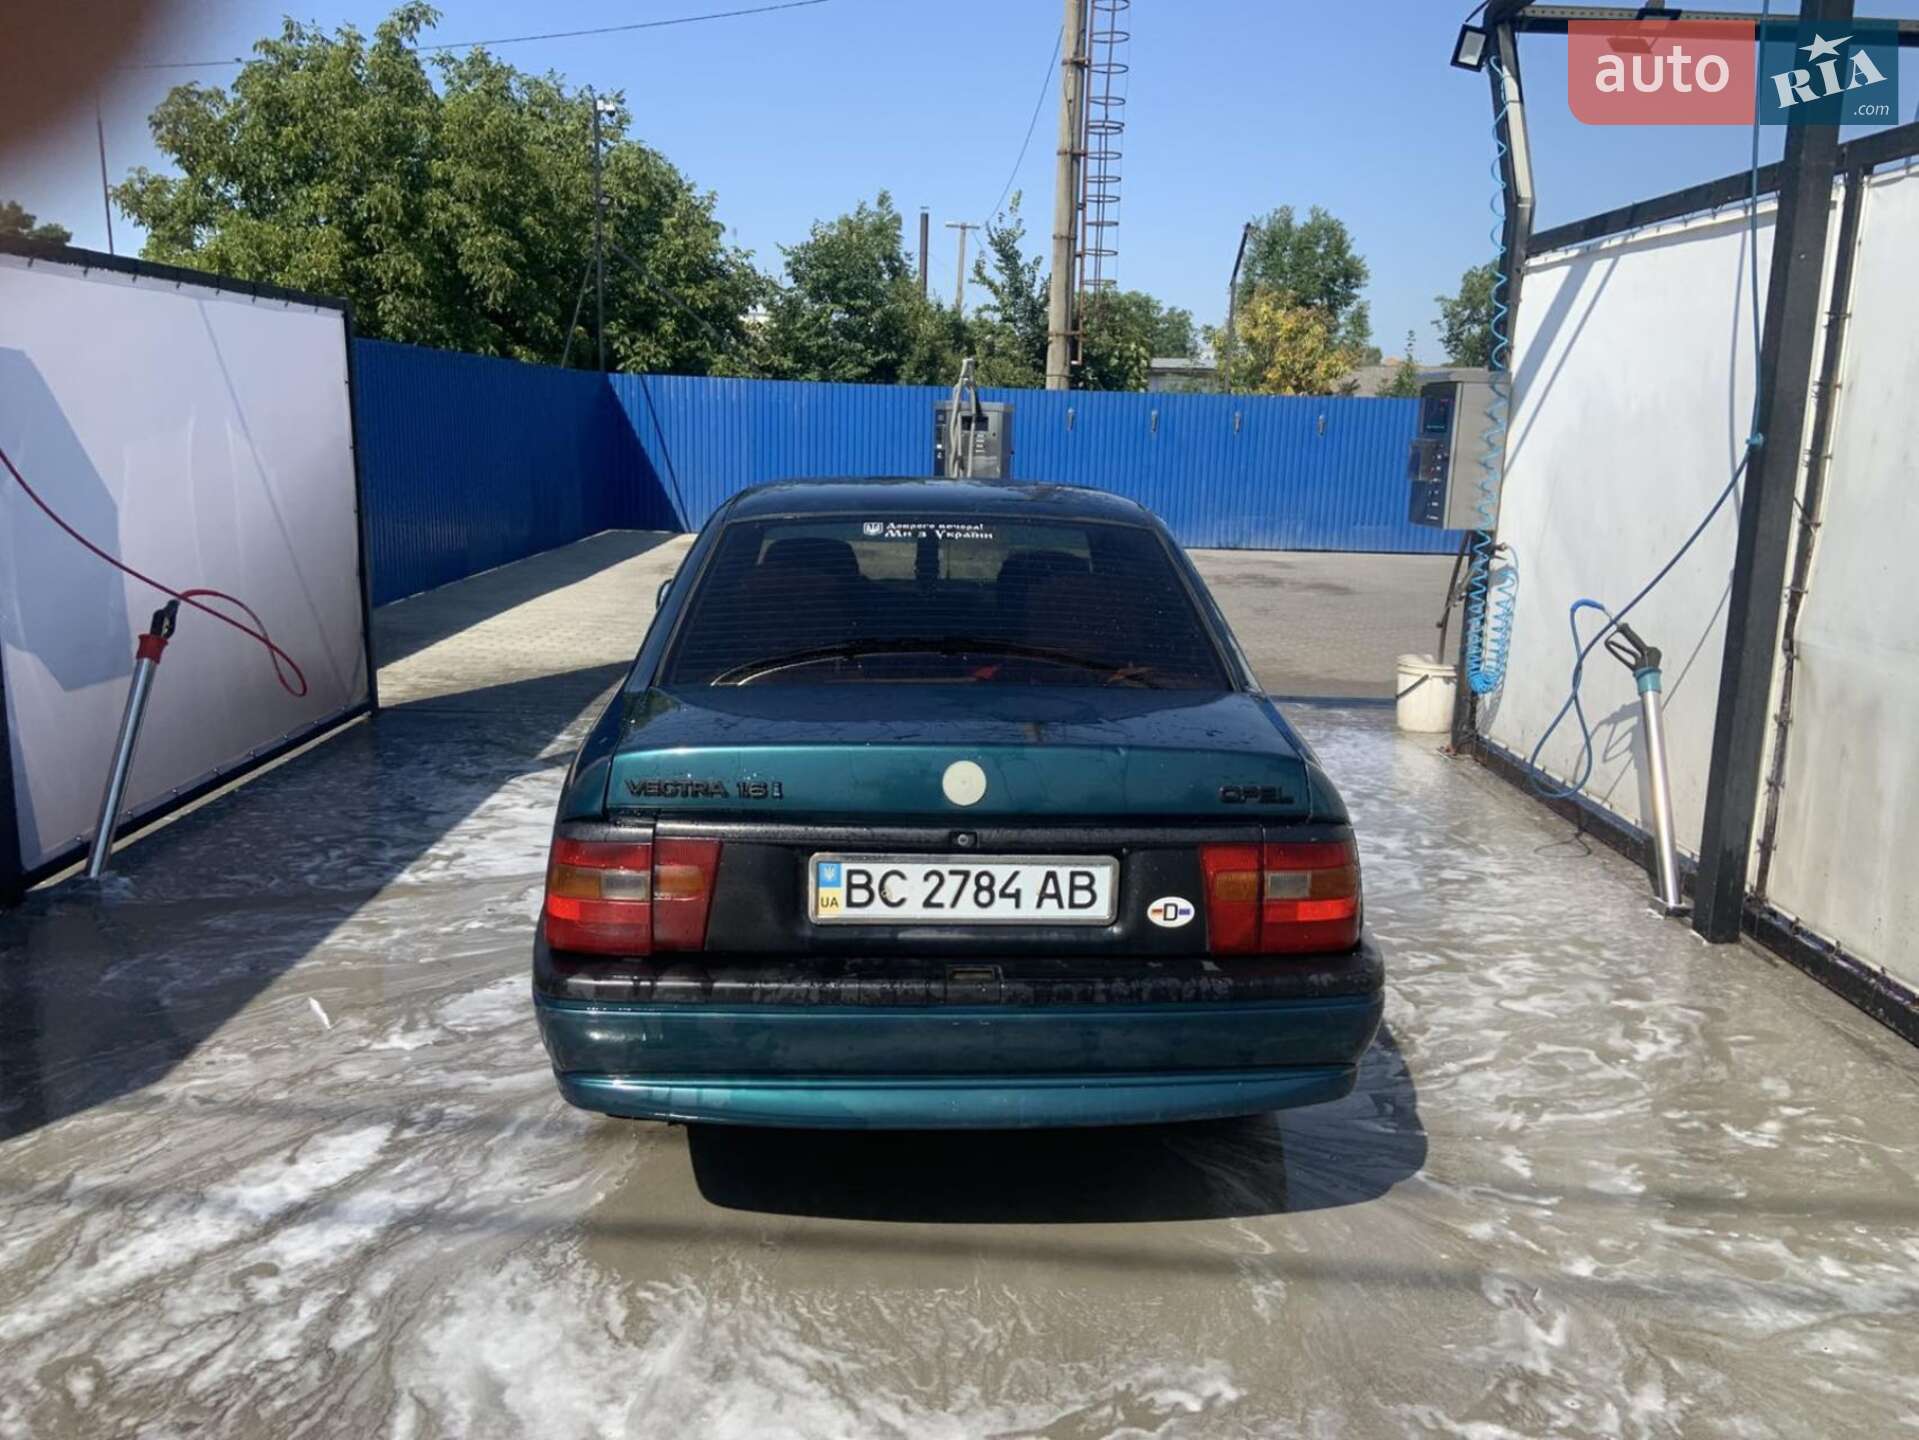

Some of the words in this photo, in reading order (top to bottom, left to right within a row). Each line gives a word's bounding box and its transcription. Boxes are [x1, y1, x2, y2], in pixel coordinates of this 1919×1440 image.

[624, 779, 730, 799] VECTRA
[1217, 784, 1295, 804] OPEL
[845, 868, 907, 910] BC
[922, 869, 1022, 910] 2784
[1036, 870, 1098, 910] AB
[820, 895, 840, 909] UA
[1163, 903, 1179, 922] D
